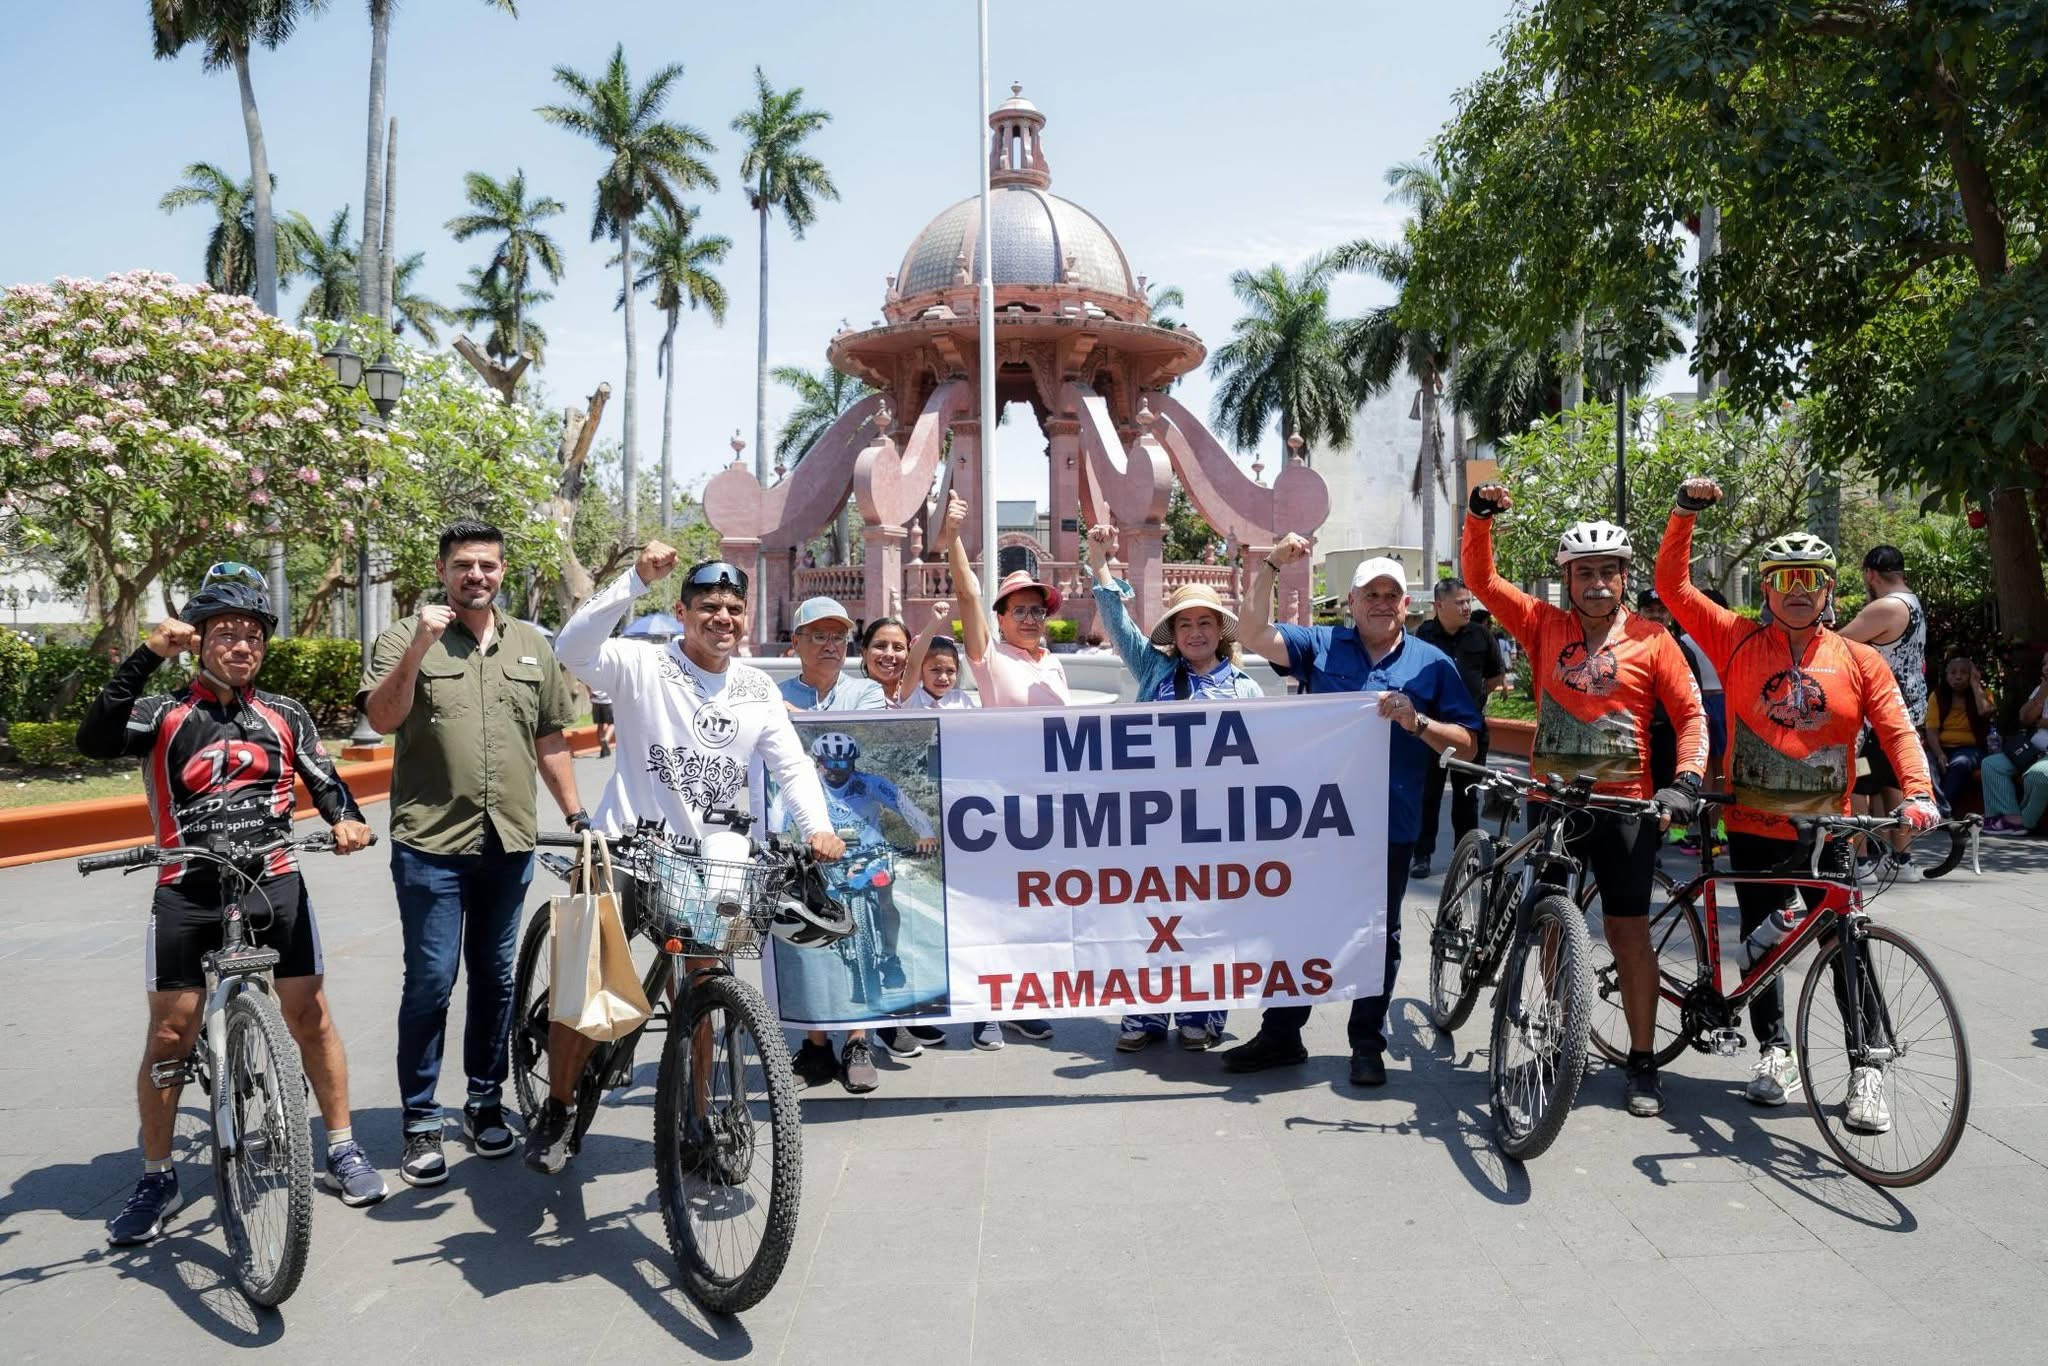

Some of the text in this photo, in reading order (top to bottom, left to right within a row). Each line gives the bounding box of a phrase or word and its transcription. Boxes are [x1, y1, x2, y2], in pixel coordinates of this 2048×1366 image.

[1043, 711, 1259, 772] META
[947, 783, 1355, 853] CUMPLIDA
[1017, 860, 1292, 908] RODANDO
[1146, 915, 1184, 954] X
[978, 958, 1335, 1012] TAMAULIPAS
